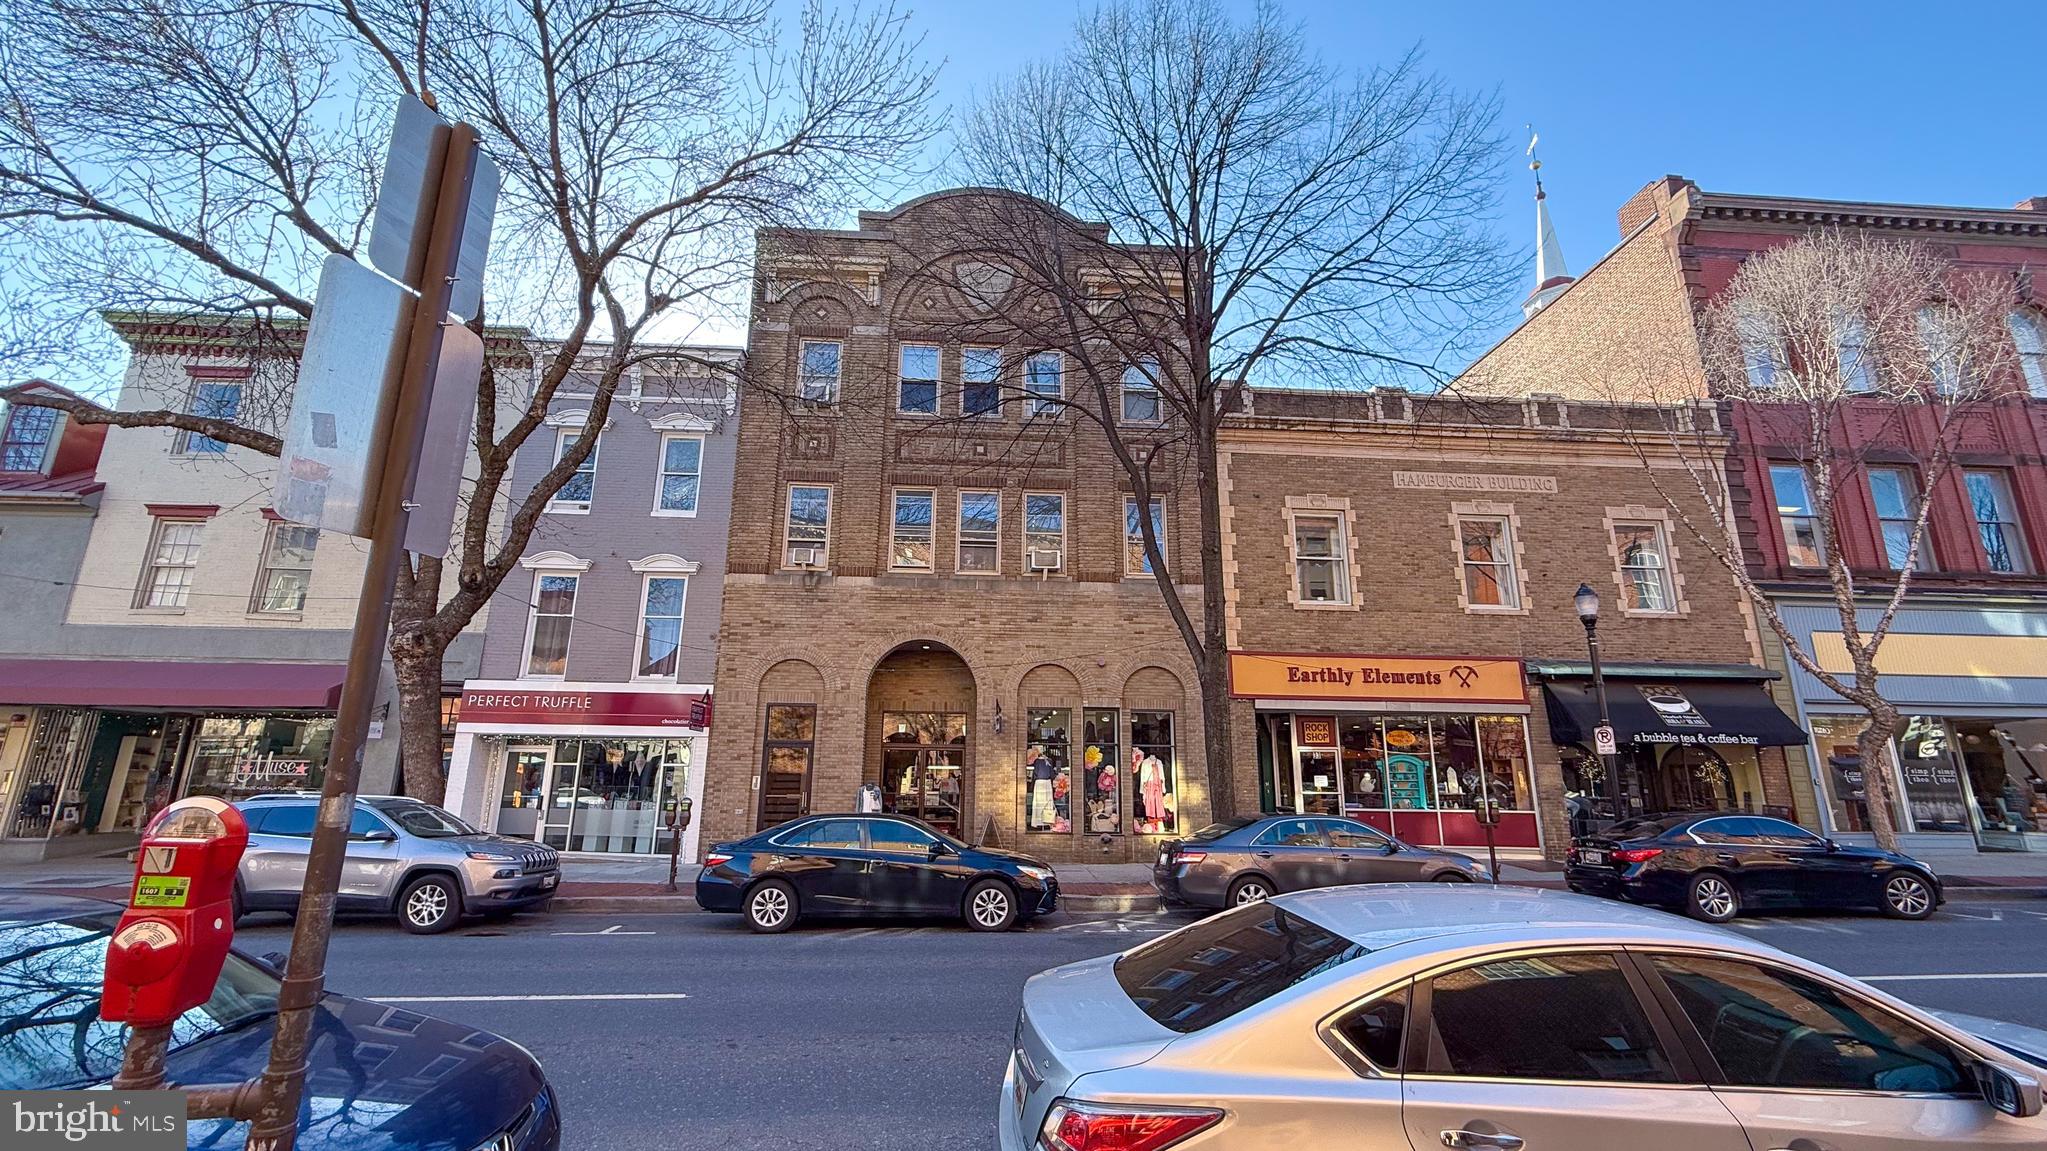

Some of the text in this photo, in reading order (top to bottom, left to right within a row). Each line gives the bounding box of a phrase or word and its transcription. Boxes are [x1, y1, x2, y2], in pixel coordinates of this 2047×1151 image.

[1397, 472, 1553, 491] HAMBURGER BUILDING
[1287, 666, 1442, 686] Earthly Elements
[468, 694, 592, 709] PERFECT TRUFFLE
[1305, 723, 1329, 732] ROCK
[1306, 732, 1329, 742] SHOP
[1633, 732, 1759, 745] a bubble tea & coffee bar
[236, 750, 297, 782] Muse
[142, 887, 159, 896] 1607
